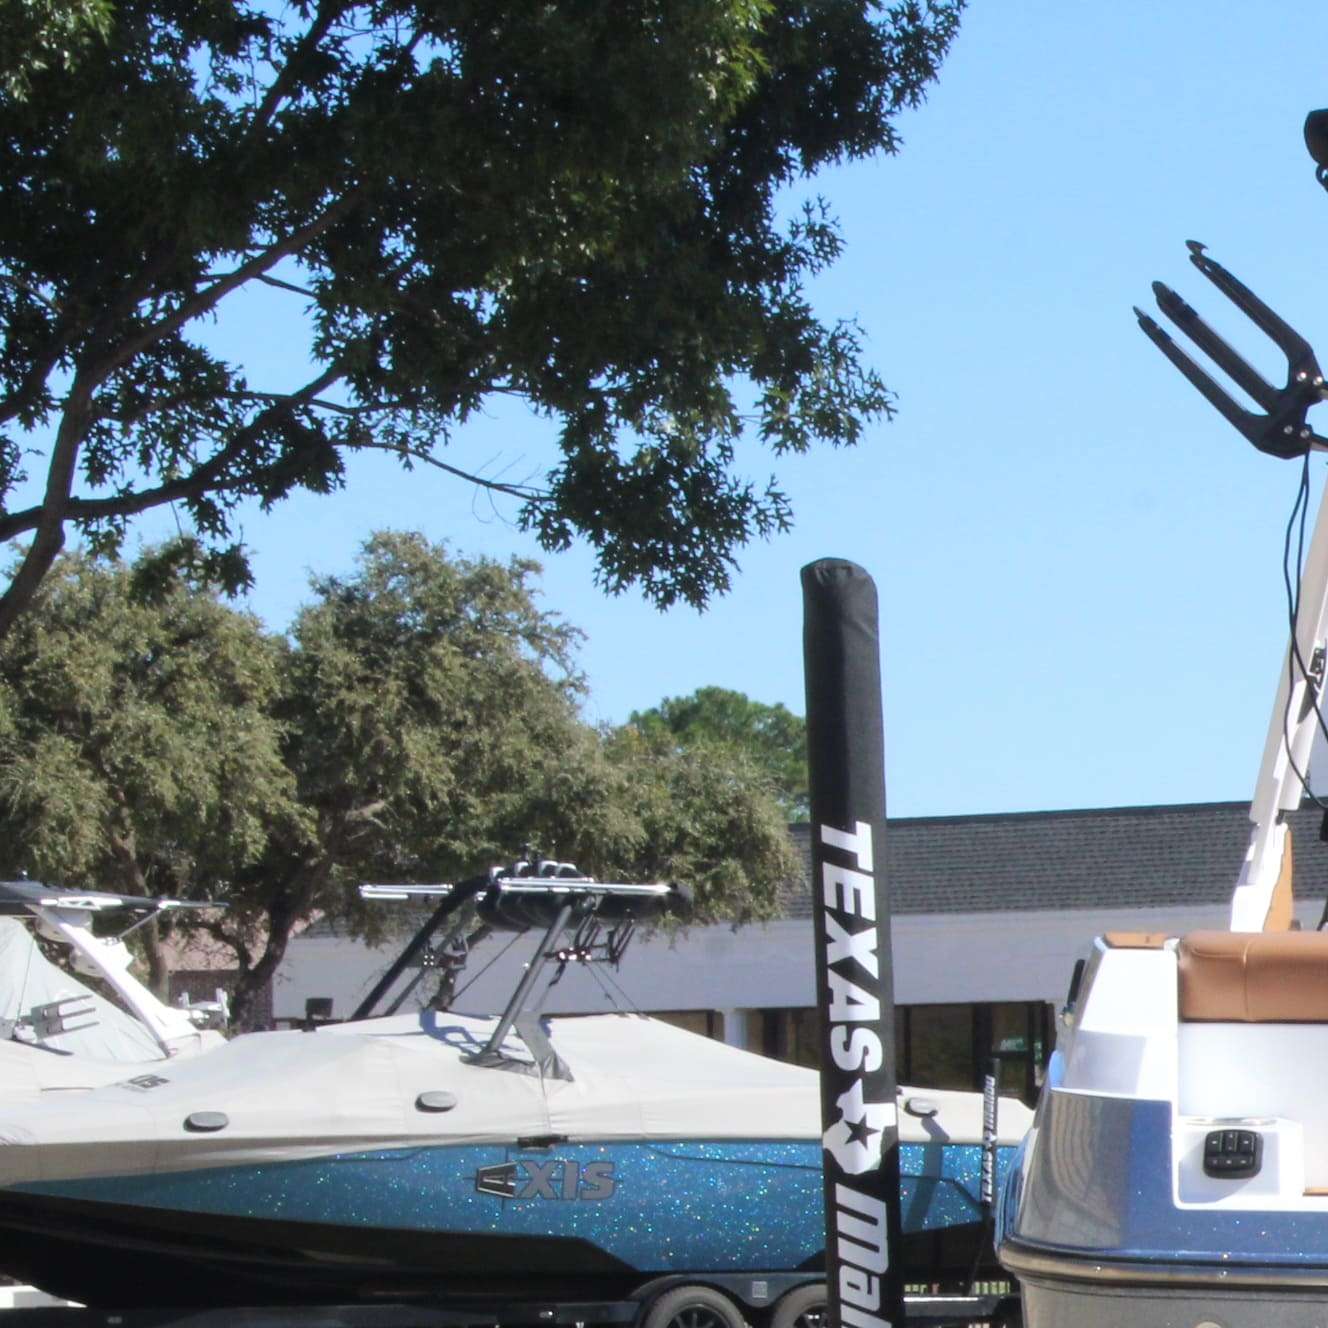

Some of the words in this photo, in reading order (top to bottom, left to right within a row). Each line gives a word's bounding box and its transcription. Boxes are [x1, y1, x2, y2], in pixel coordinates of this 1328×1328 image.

[820, 820, 884, 1074] TEXAS
[475, 1159, 617, 1201] AXIS
[981, 1151, 993, 1203] TEXAS
